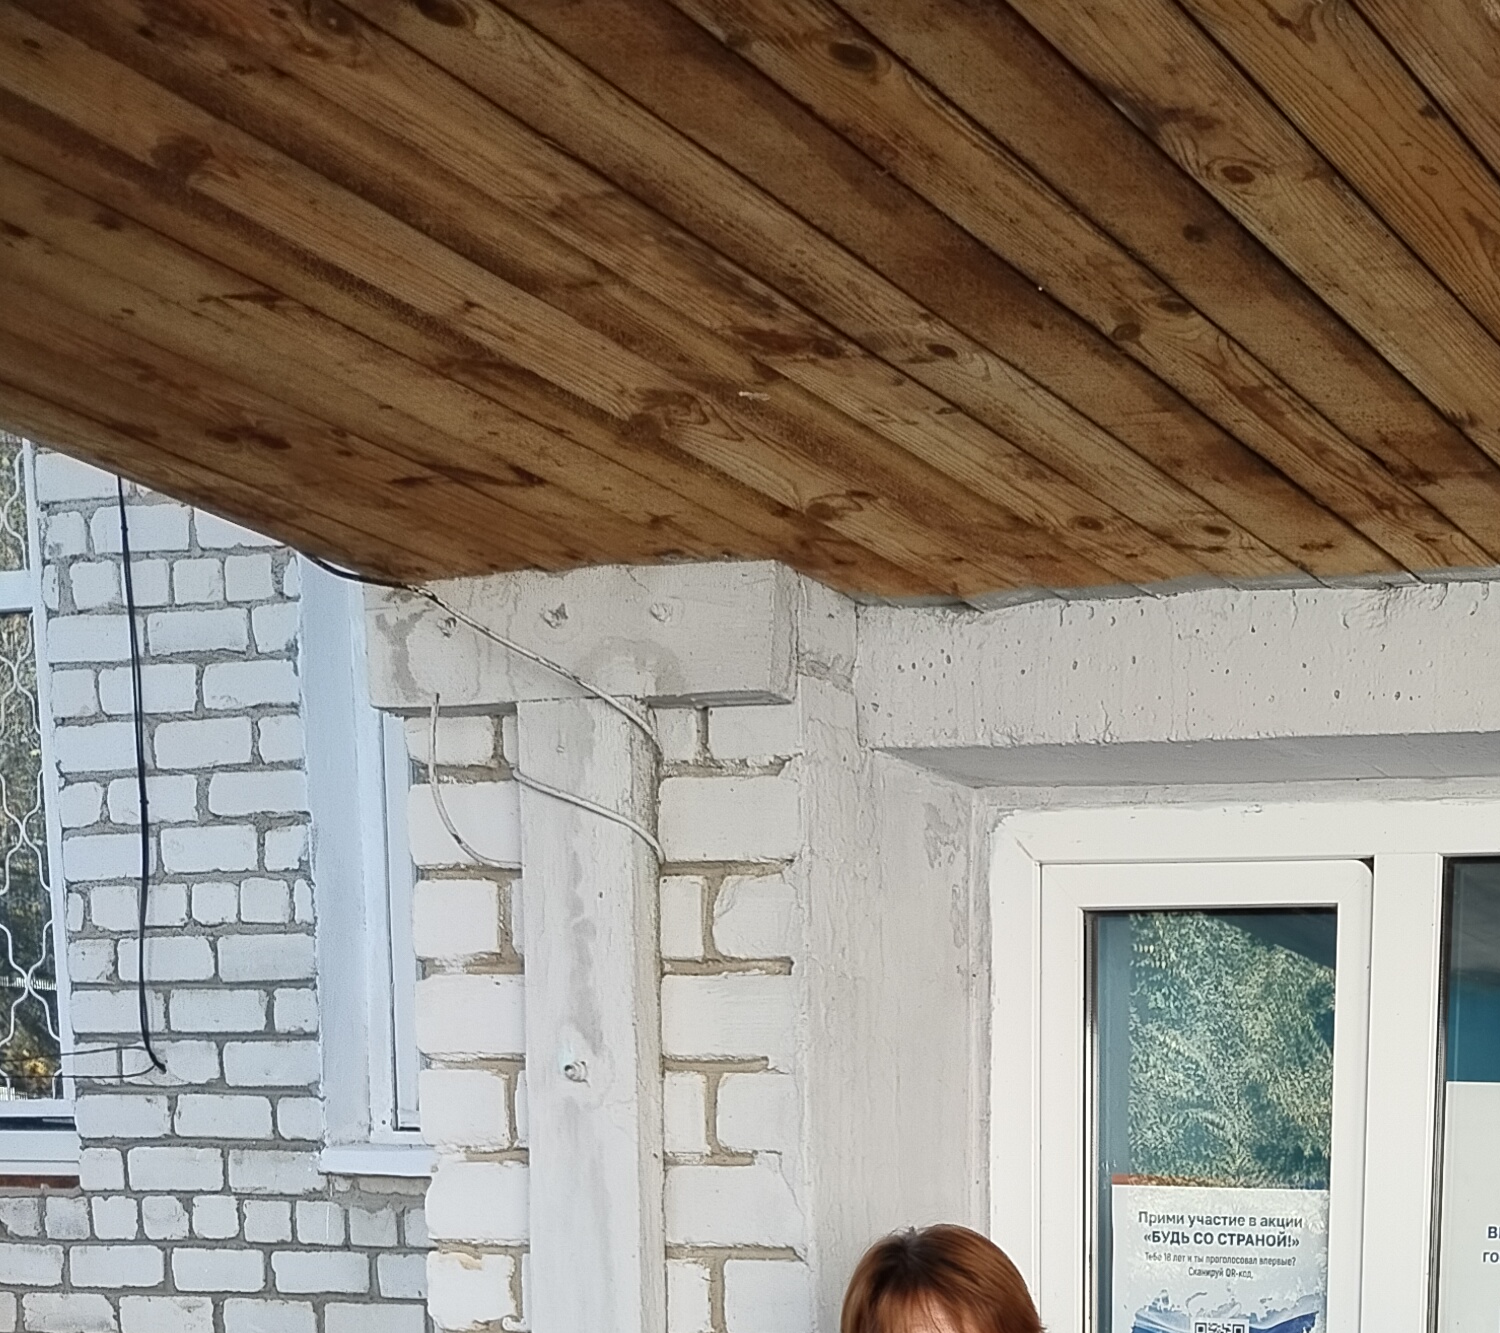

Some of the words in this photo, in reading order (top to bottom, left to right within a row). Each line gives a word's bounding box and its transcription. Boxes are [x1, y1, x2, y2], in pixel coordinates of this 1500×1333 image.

[1139, 1211, 1184, 1226] Прими
[1188, 1215, 1245, 1228] участие
[1249, 1217, 1256, 1226] в
[1260, 1217, 1303, 1229] акции
[1144, 1231, 1190, 1245] «БУДЬ
[1193, 1232, 1214, 1244] СО
[1218, 1231, 1300, 1247] СТРАНОЙ!»
[1164, 1253, 1171, 1261] 18
[1206, 1256, 1257, 1264] проголосовал
[1259, 1257, 1296, 1266] впервые?
[1189, 1267, 1223, 1279] Сканируй
